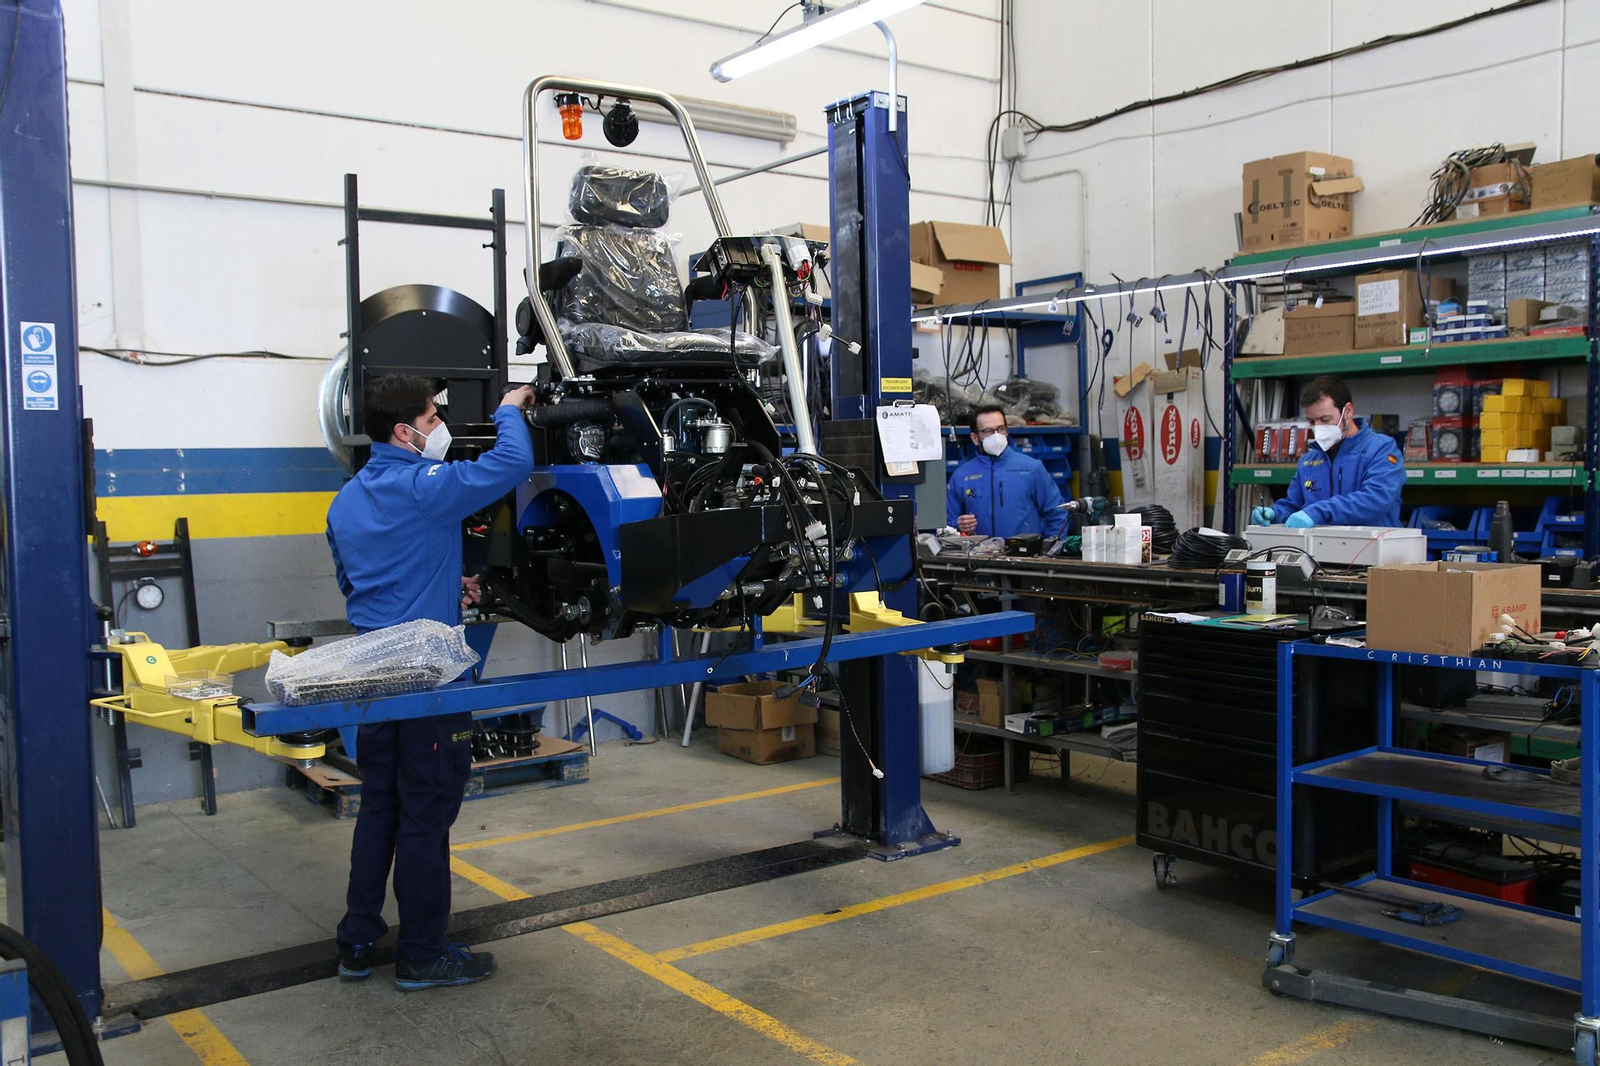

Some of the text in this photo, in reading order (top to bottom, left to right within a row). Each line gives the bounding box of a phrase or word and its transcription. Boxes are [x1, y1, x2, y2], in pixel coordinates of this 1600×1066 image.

[1166, 407, 1176, 462] Unex
[1140, 614, 1162, 623] BAHCO
[1502, 604, 1527, 614] KRAMP
[1148, 801, 1277, 866] BAHCO
